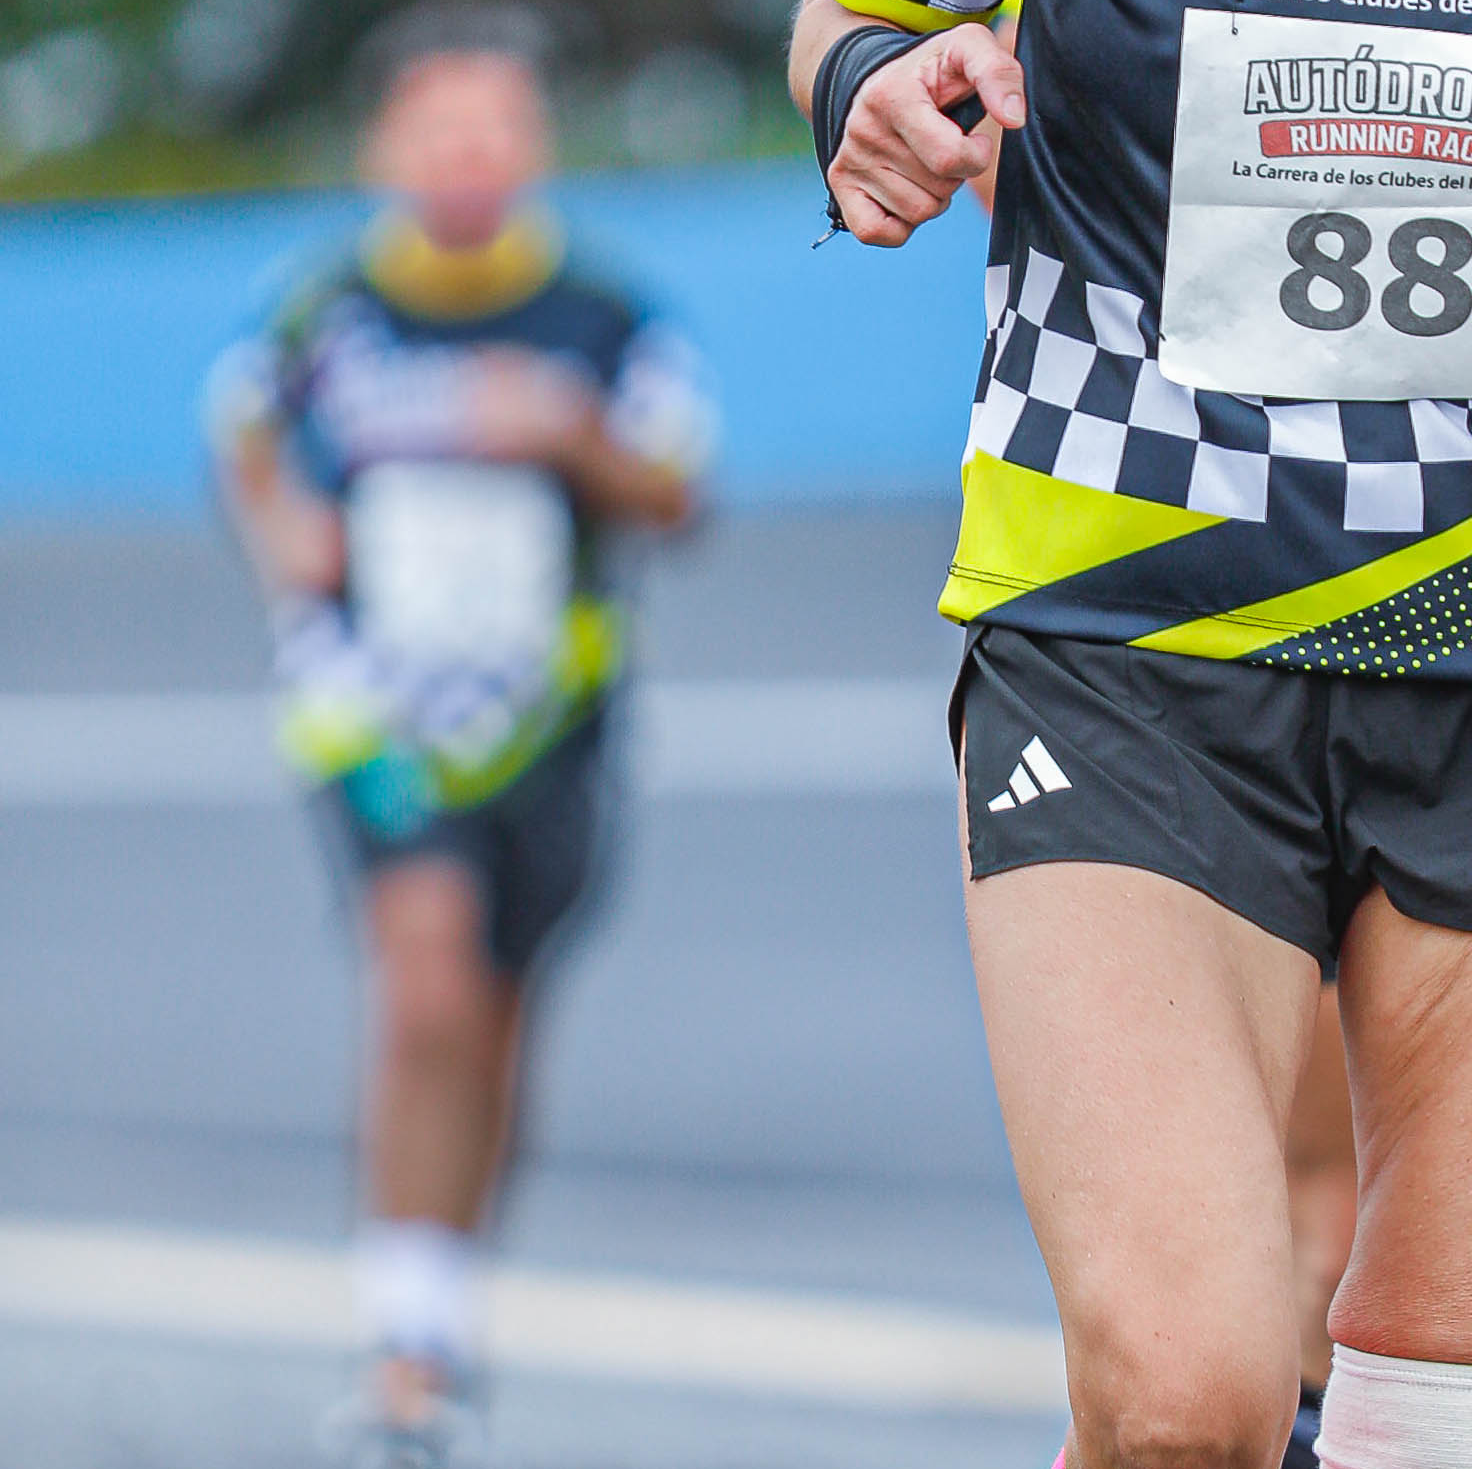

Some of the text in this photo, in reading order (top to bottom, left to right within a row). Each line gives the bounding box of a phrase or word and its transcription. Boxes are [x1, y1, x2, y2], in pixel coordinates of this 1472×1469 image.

[1290, 122, 1414, 154] RUNNING
[1232, 160, 1252, 177] La
[1256, 162, 1319, 183] Carrera
[1323, 168, 1346, 184] de
[1350, 169, 1374, 186] los
[1378, 170, 1434, 189] Clubes
[1438, 174, 1465, 190] del
